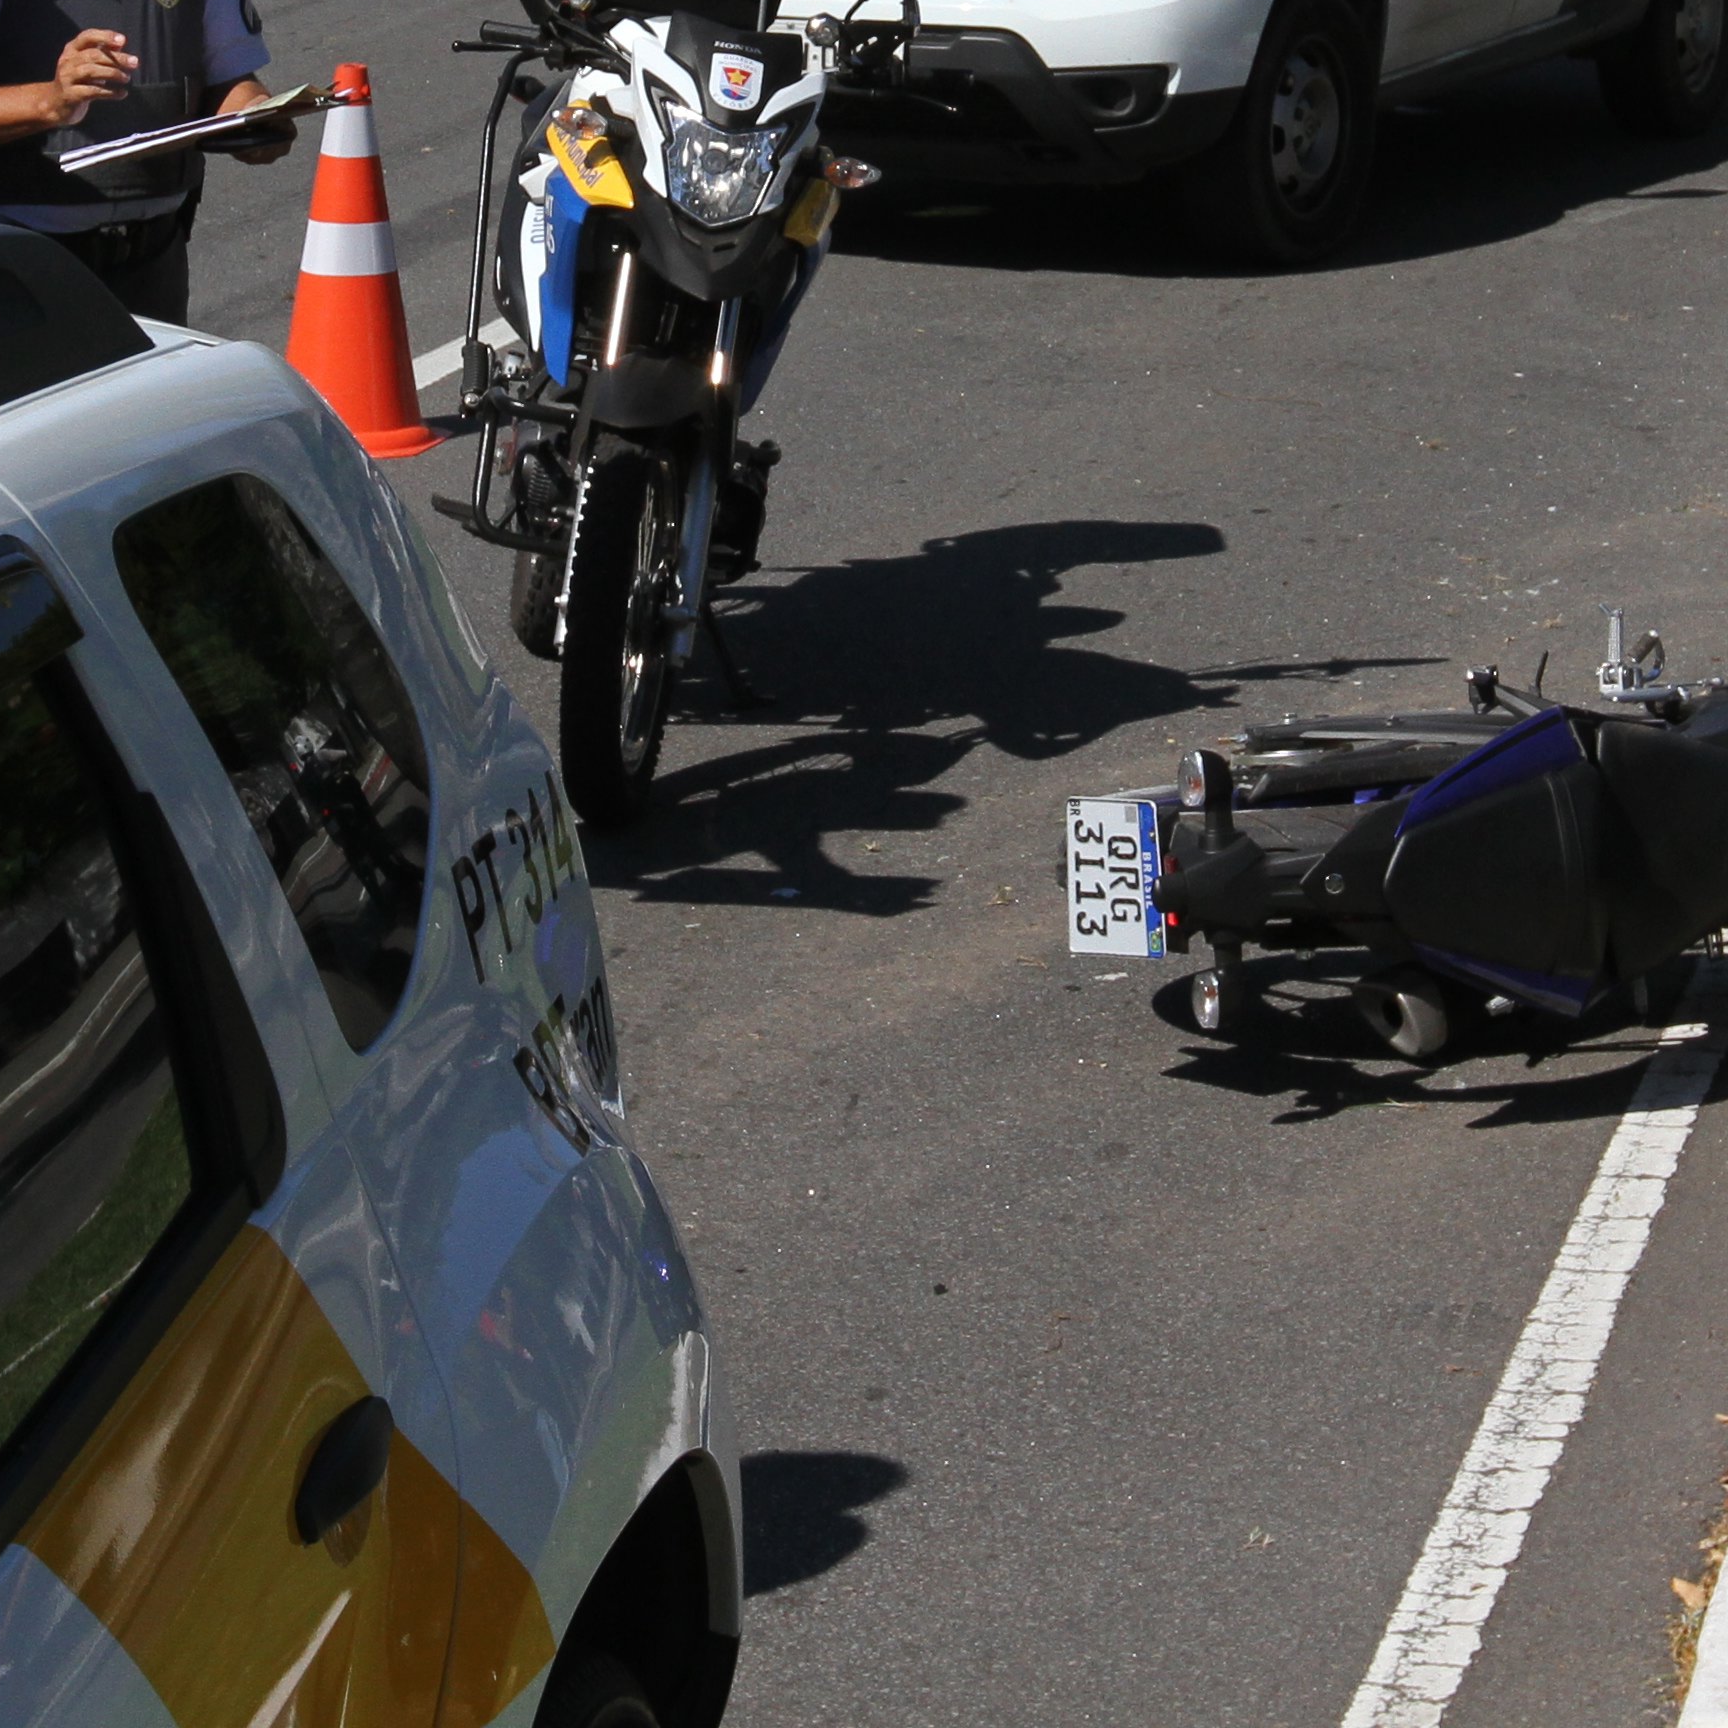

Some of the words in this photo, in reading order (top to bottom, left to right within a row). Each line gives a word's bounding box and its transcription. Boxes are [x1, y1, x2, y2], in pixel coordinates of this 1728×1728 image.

[713, 40, 763, 55] HONDA
[451, 827, 512, 986] PT
[504, 770, 576, 925] 314
[1108, 835, 1142, 923] QRG
[1142, 851, 1155, 910] BRASIL
